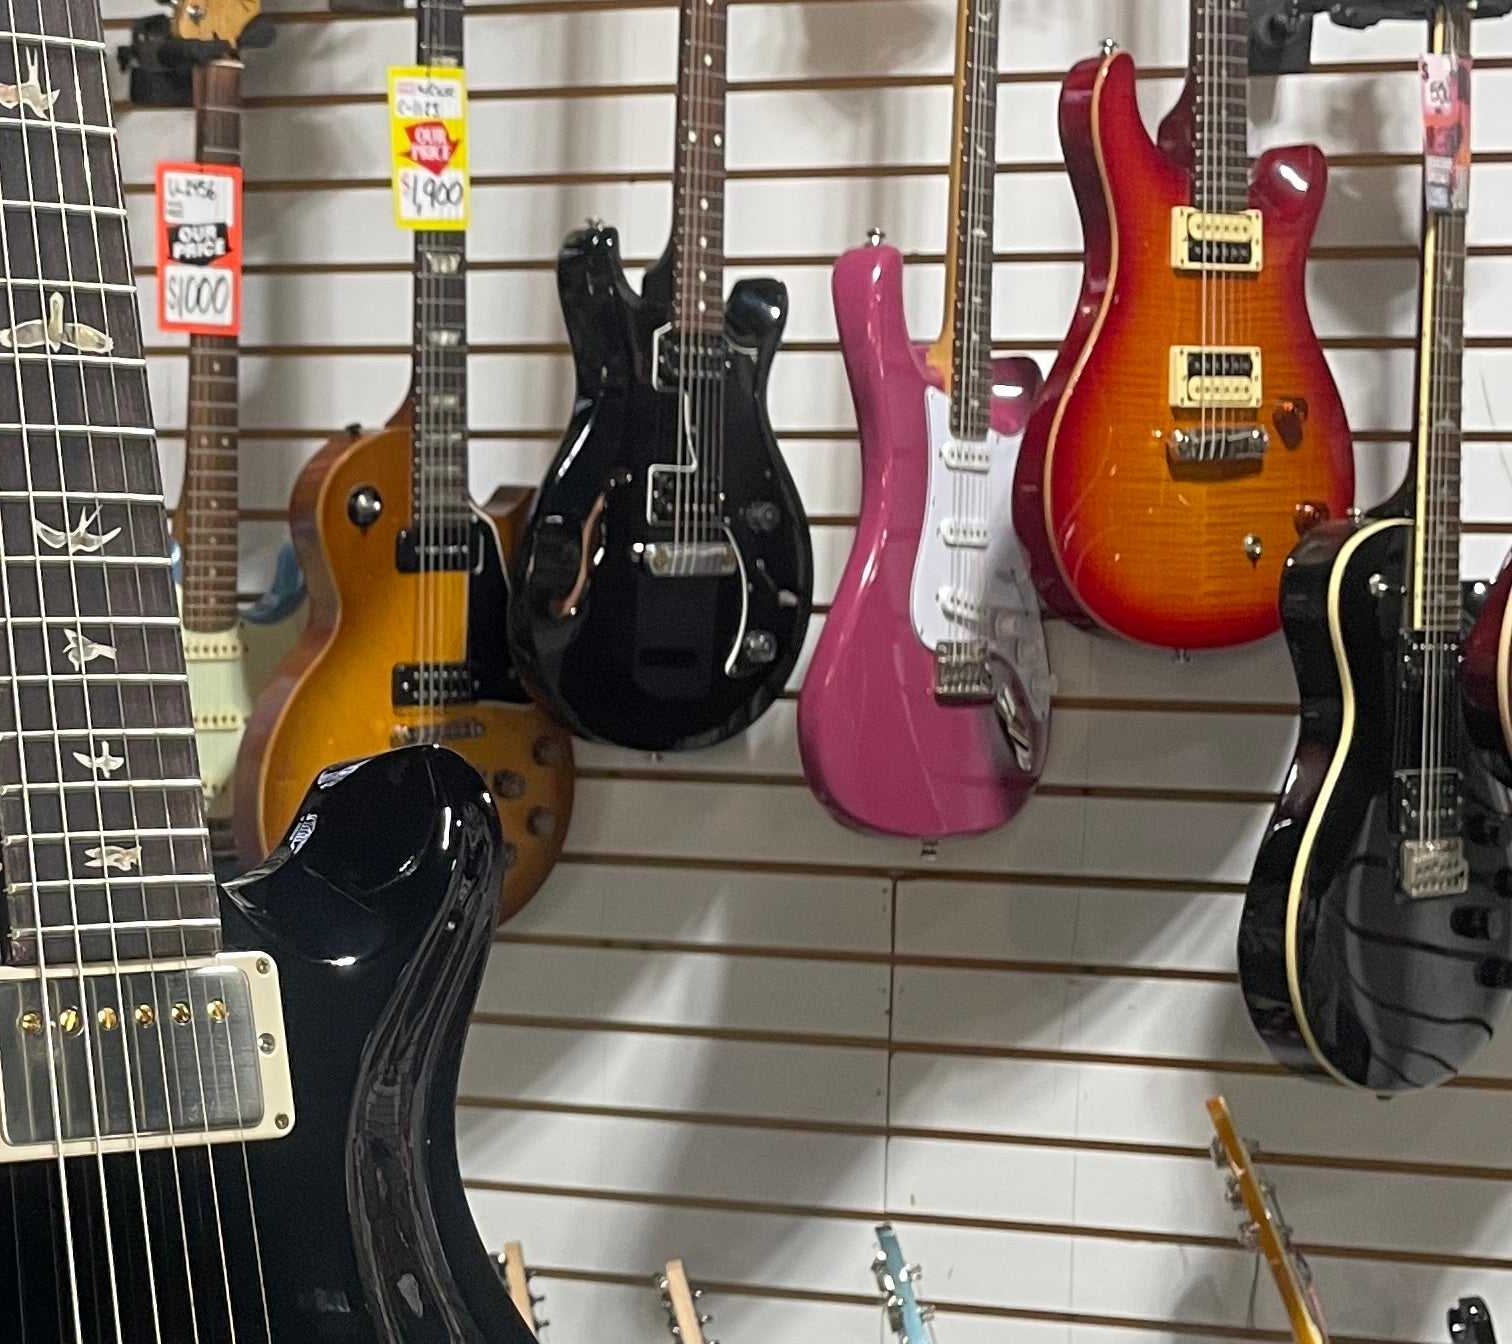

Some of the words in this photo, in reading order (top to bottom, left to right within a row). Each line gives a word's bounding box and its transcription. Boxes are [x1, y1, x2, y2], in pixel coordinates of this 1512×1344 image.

[178, 224, 218, 244] OUR
[172, 237, 227, 260] PRICE
[168, 274, 230, 319] $1000
